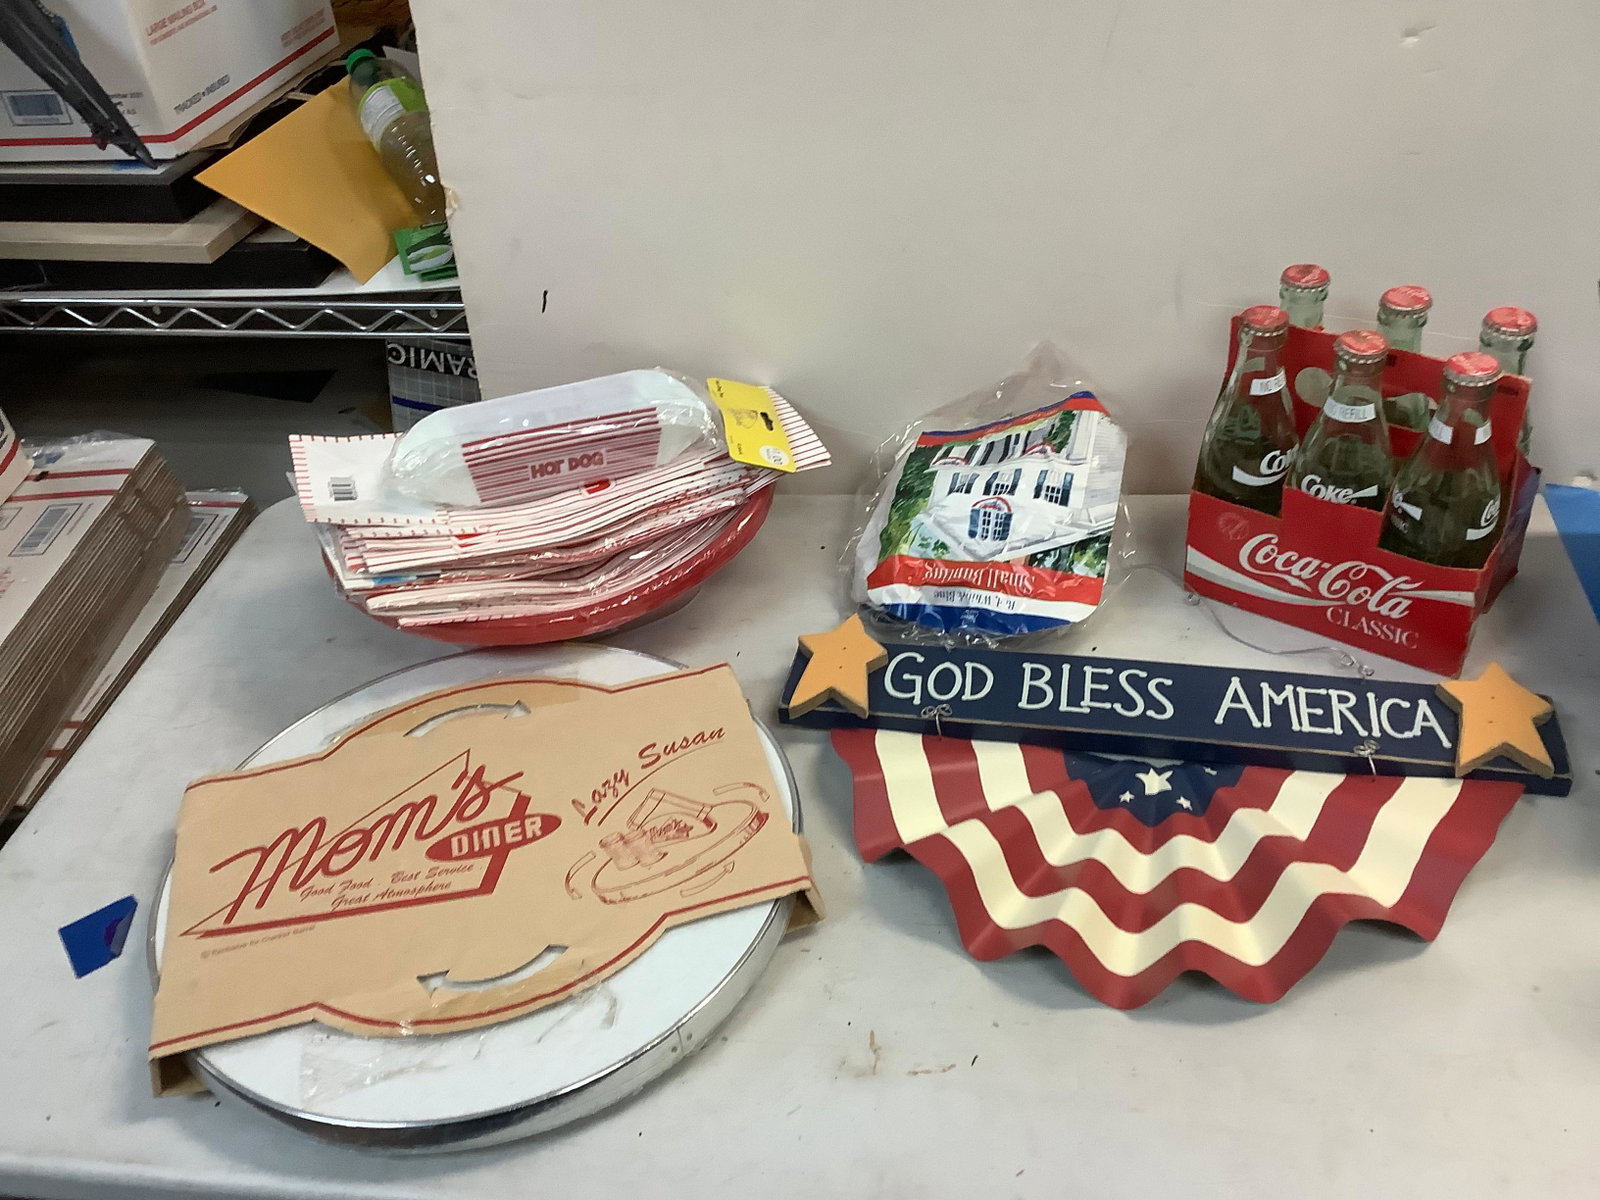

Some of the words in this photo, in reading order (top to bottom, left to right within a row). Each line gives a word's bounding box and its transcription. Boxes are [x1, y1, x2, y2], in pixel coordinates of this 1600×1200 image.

[531, 459, 564, 479] HOT
[568, 451, 604, 471] DOG
[922, 561, 984, 587] Bunting
[986, 568, 1035, 595] Small
[1239, 532, 1424, 620] Coca-Cola
[1326, 606, 1419, 649] CLASSIC
[884, 651, 994, 705] GOD
[1018, 661, 1175, 720] BLESS
[1214, 676, 1452, 749] AMERICA
[571, 768, 630, 826] Lazy
[638, 727, 726, 769] Susan
[209, 763, 525, 925] Mom's
[451, 815, 543, 858] DINER
[300, 882, 336, 902] Good
[338, 877, 375, 894] Food
[390, 870, 422, 885] Best
[425, 863, 474, 880] Service
[330, 893, 371, 912] Great
[372, 880, 453, 902] Atmosphere
